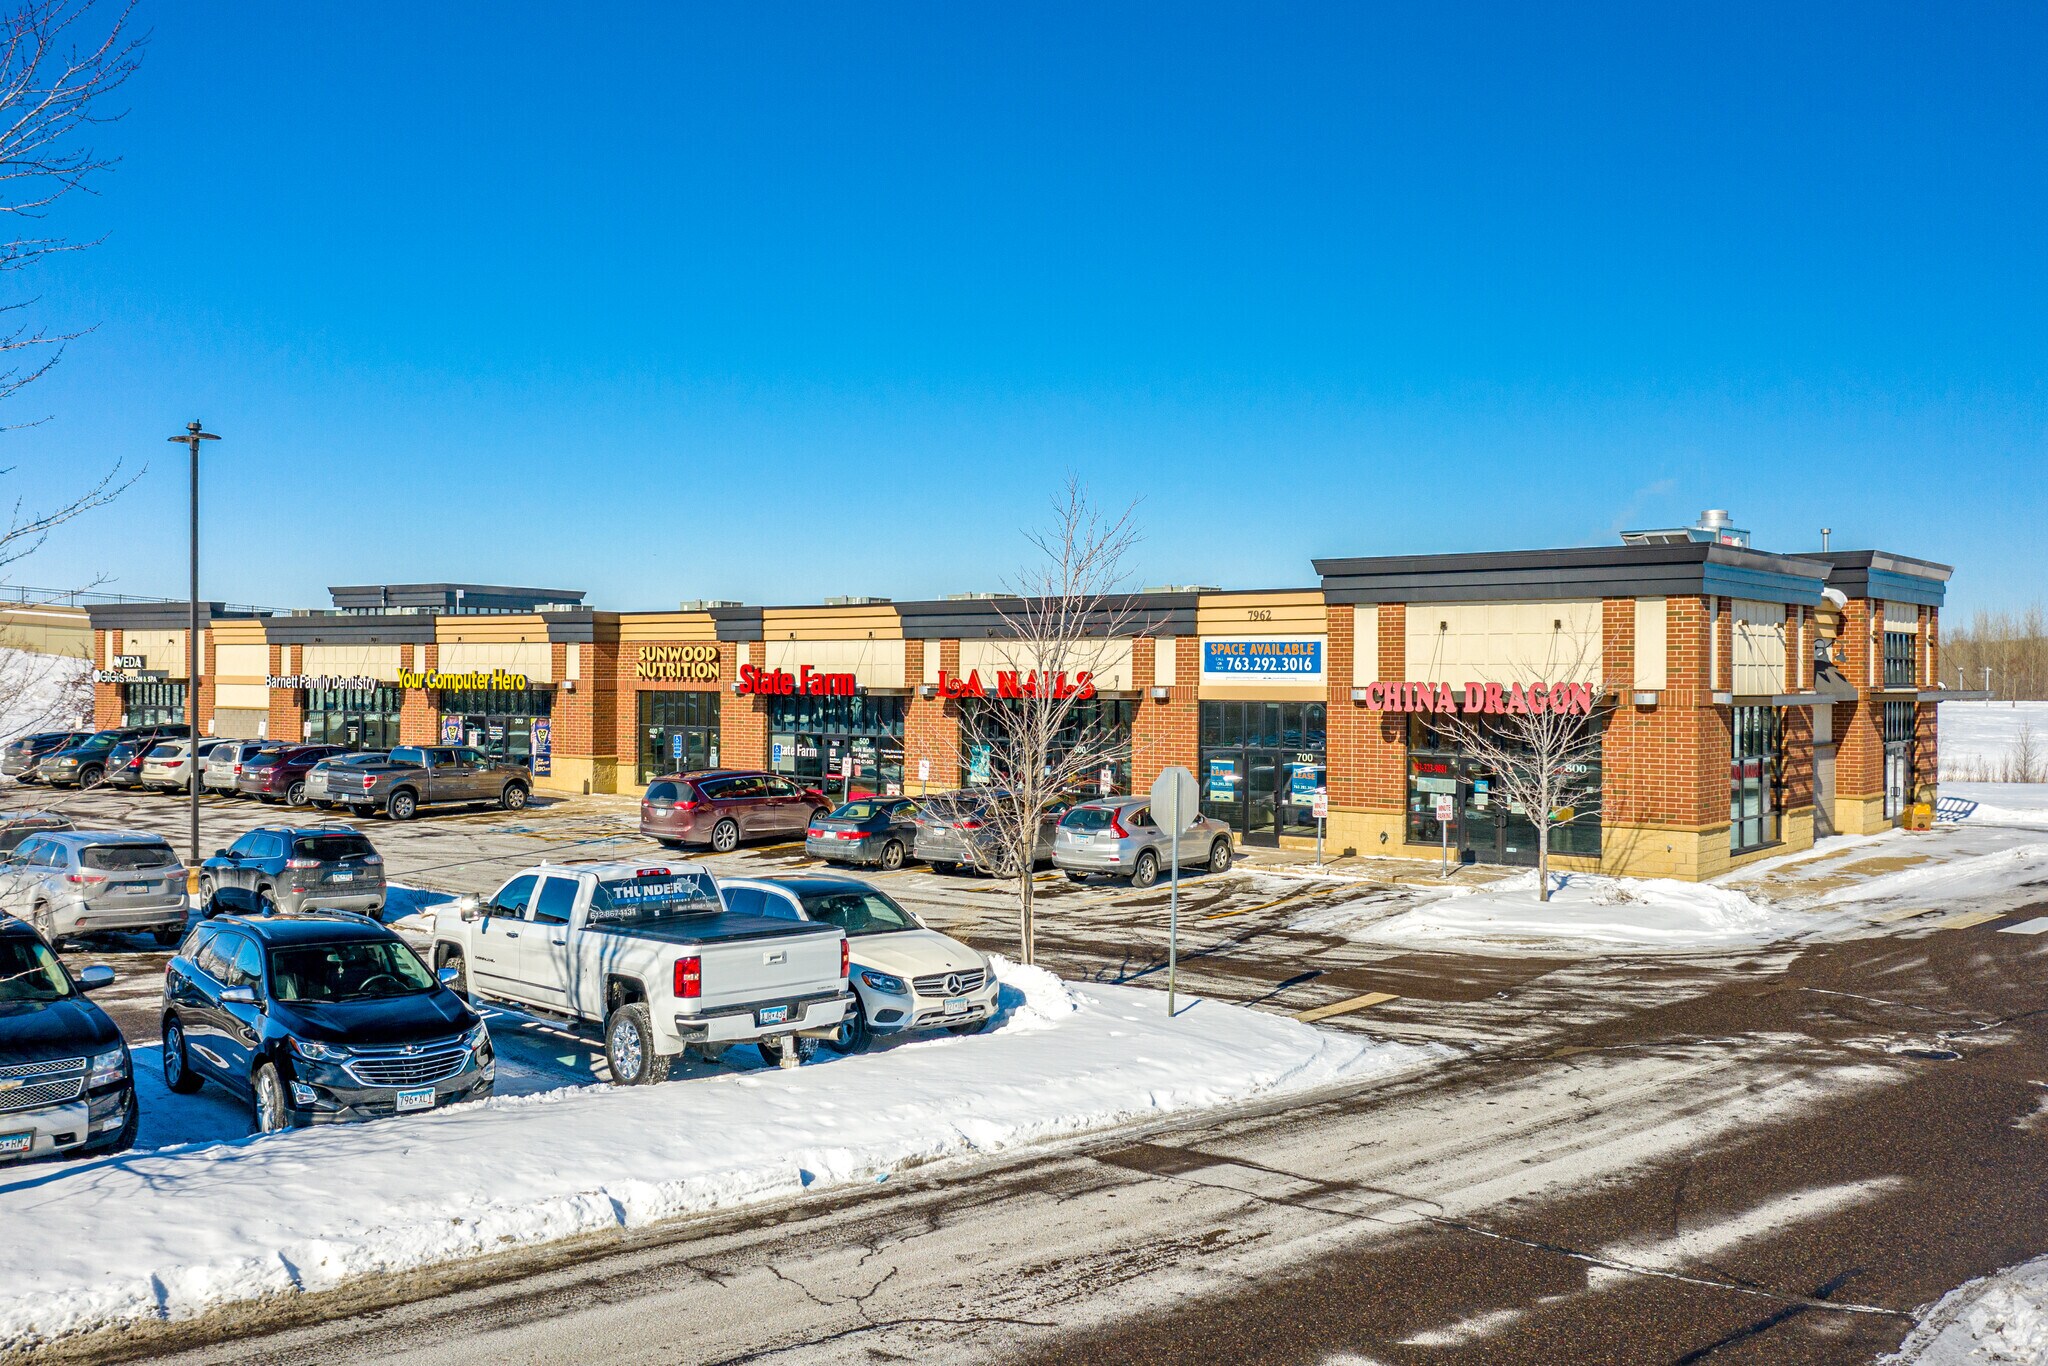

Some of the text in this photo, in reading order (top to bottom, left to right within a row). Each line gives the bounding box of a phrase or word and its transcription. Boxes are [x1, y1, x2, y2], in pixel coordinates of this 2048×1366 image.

[1247, 610, 1272, 621] 7962
[638, 646, 717, 661] SUNWOOD
[1211, 643, 1315, 655] SPACE AVAILABLE
[113, 655, 142, 668] AVEDA
[1226, 657, 1313, 671] 763.292.3016
[636, 662, 720, 678] NUTRITION
[265, 674, 377, 694] Barnett Family Dentistry
[396, 667, 526, 694] Your Computer Hero
[739, 664, 855, 696] State Farm
[1365, 681, 1593, 714] CHINA DRAGON
[781, 743, 818, 757] tate Farm
[1296, 753, 1314, 762] 700
[1293, 771, 1316, 780] LEASE
[1565, 764, 1587, 773] 800
[612, 882, 683, 899] THUNDER
